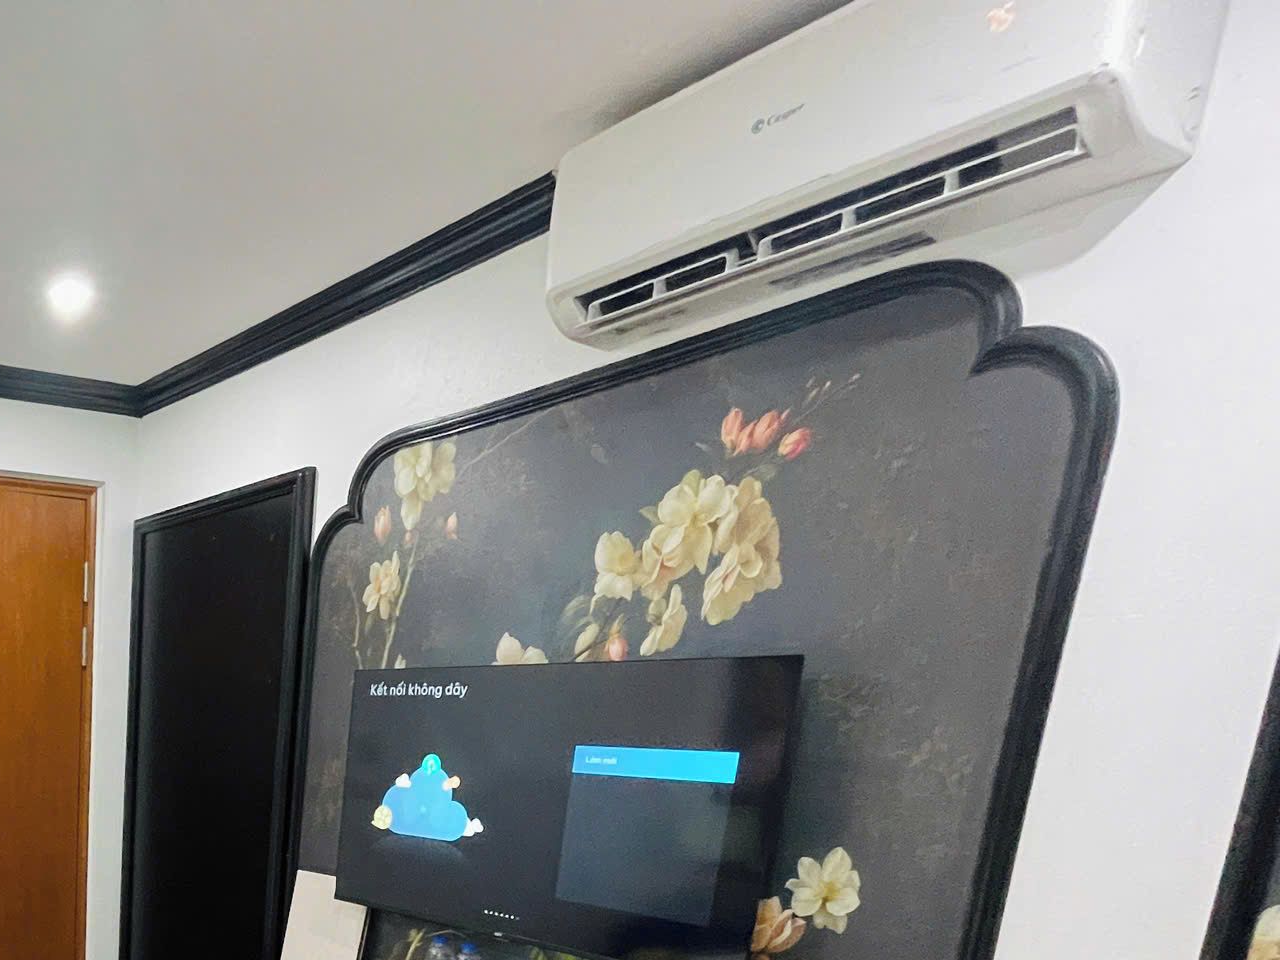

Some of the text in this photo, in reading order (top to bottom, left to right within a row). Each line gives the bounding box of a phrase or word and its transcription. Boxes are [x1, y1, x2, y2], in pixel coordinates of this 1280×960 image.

[370, 681, 468, 699] Kết nối không dây
